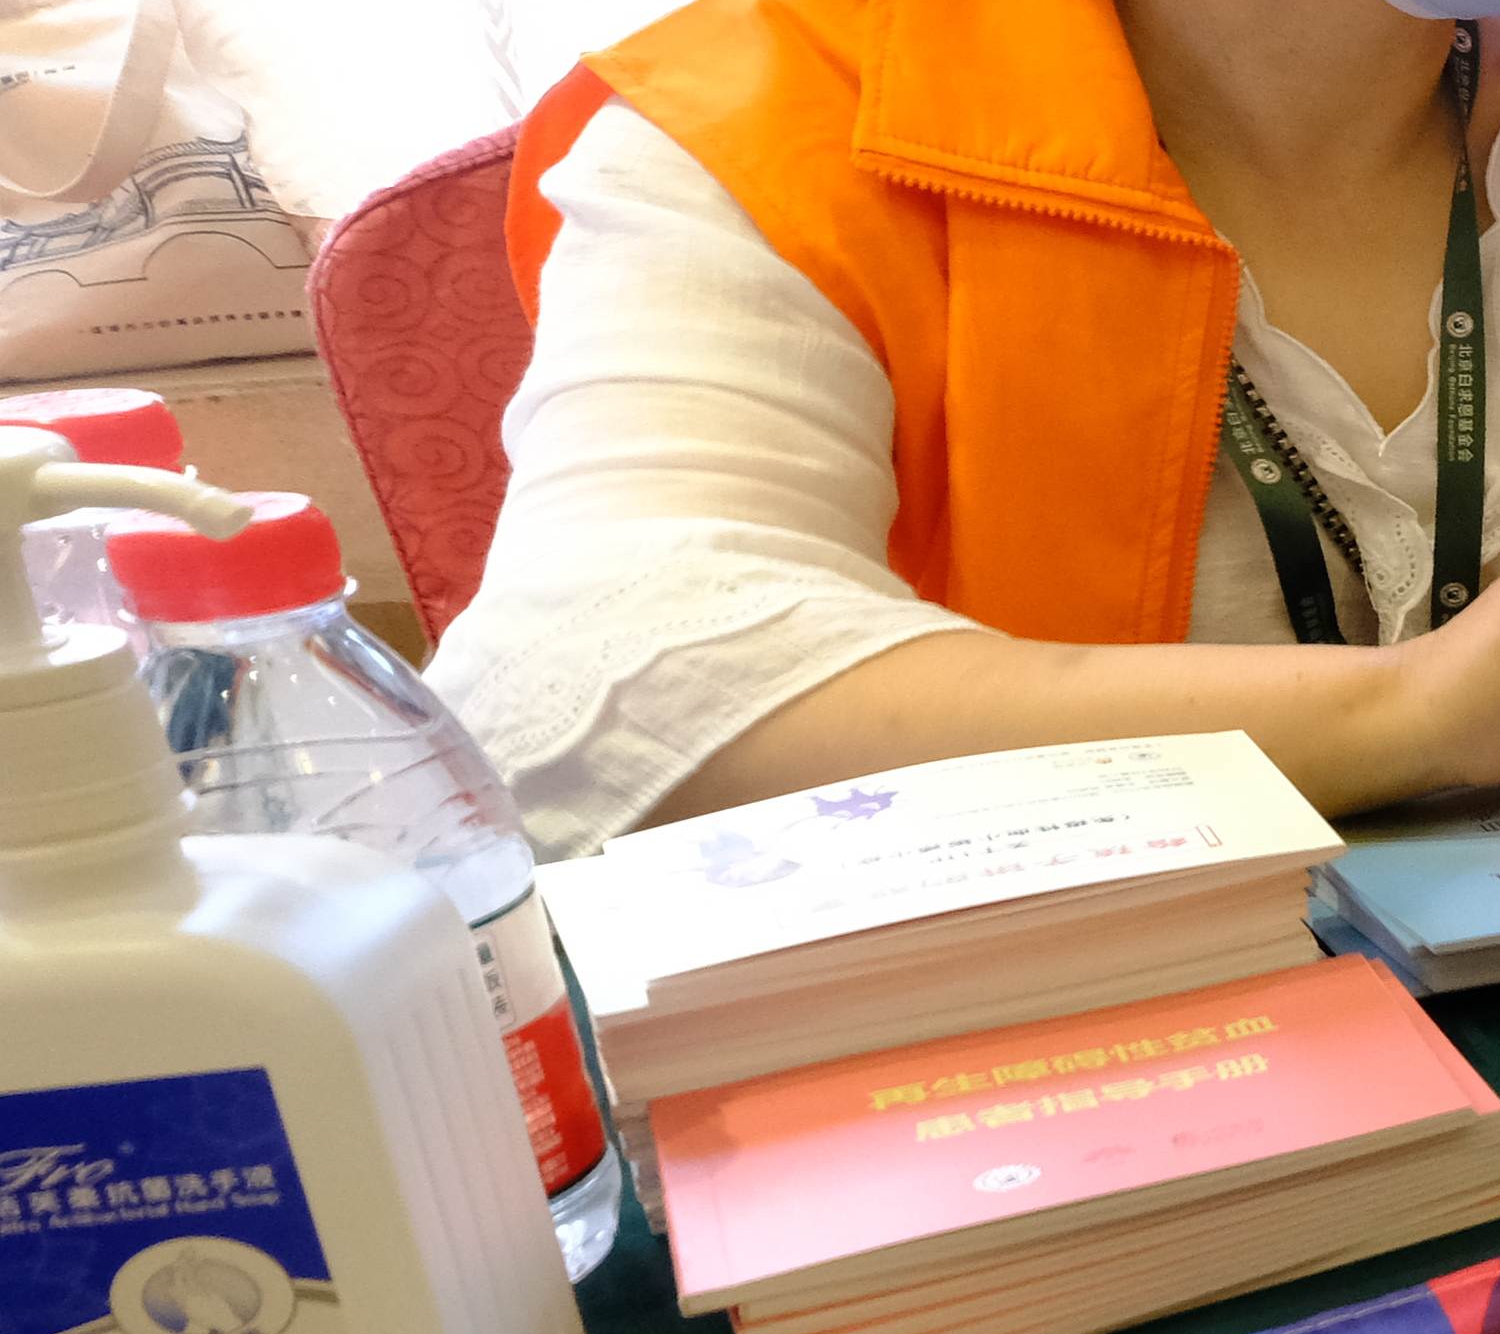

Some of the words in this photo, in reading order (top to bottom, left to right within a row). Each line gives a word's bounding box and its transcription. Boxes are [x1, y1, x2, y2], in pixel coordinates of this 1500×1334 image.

[1457, 343, 1475, 463] 北京白求恩基金会
[868, 1015, 1277, 1111] 再生障碍性贫血
[915, 1053, 1269, 1142] 患者指导手册
